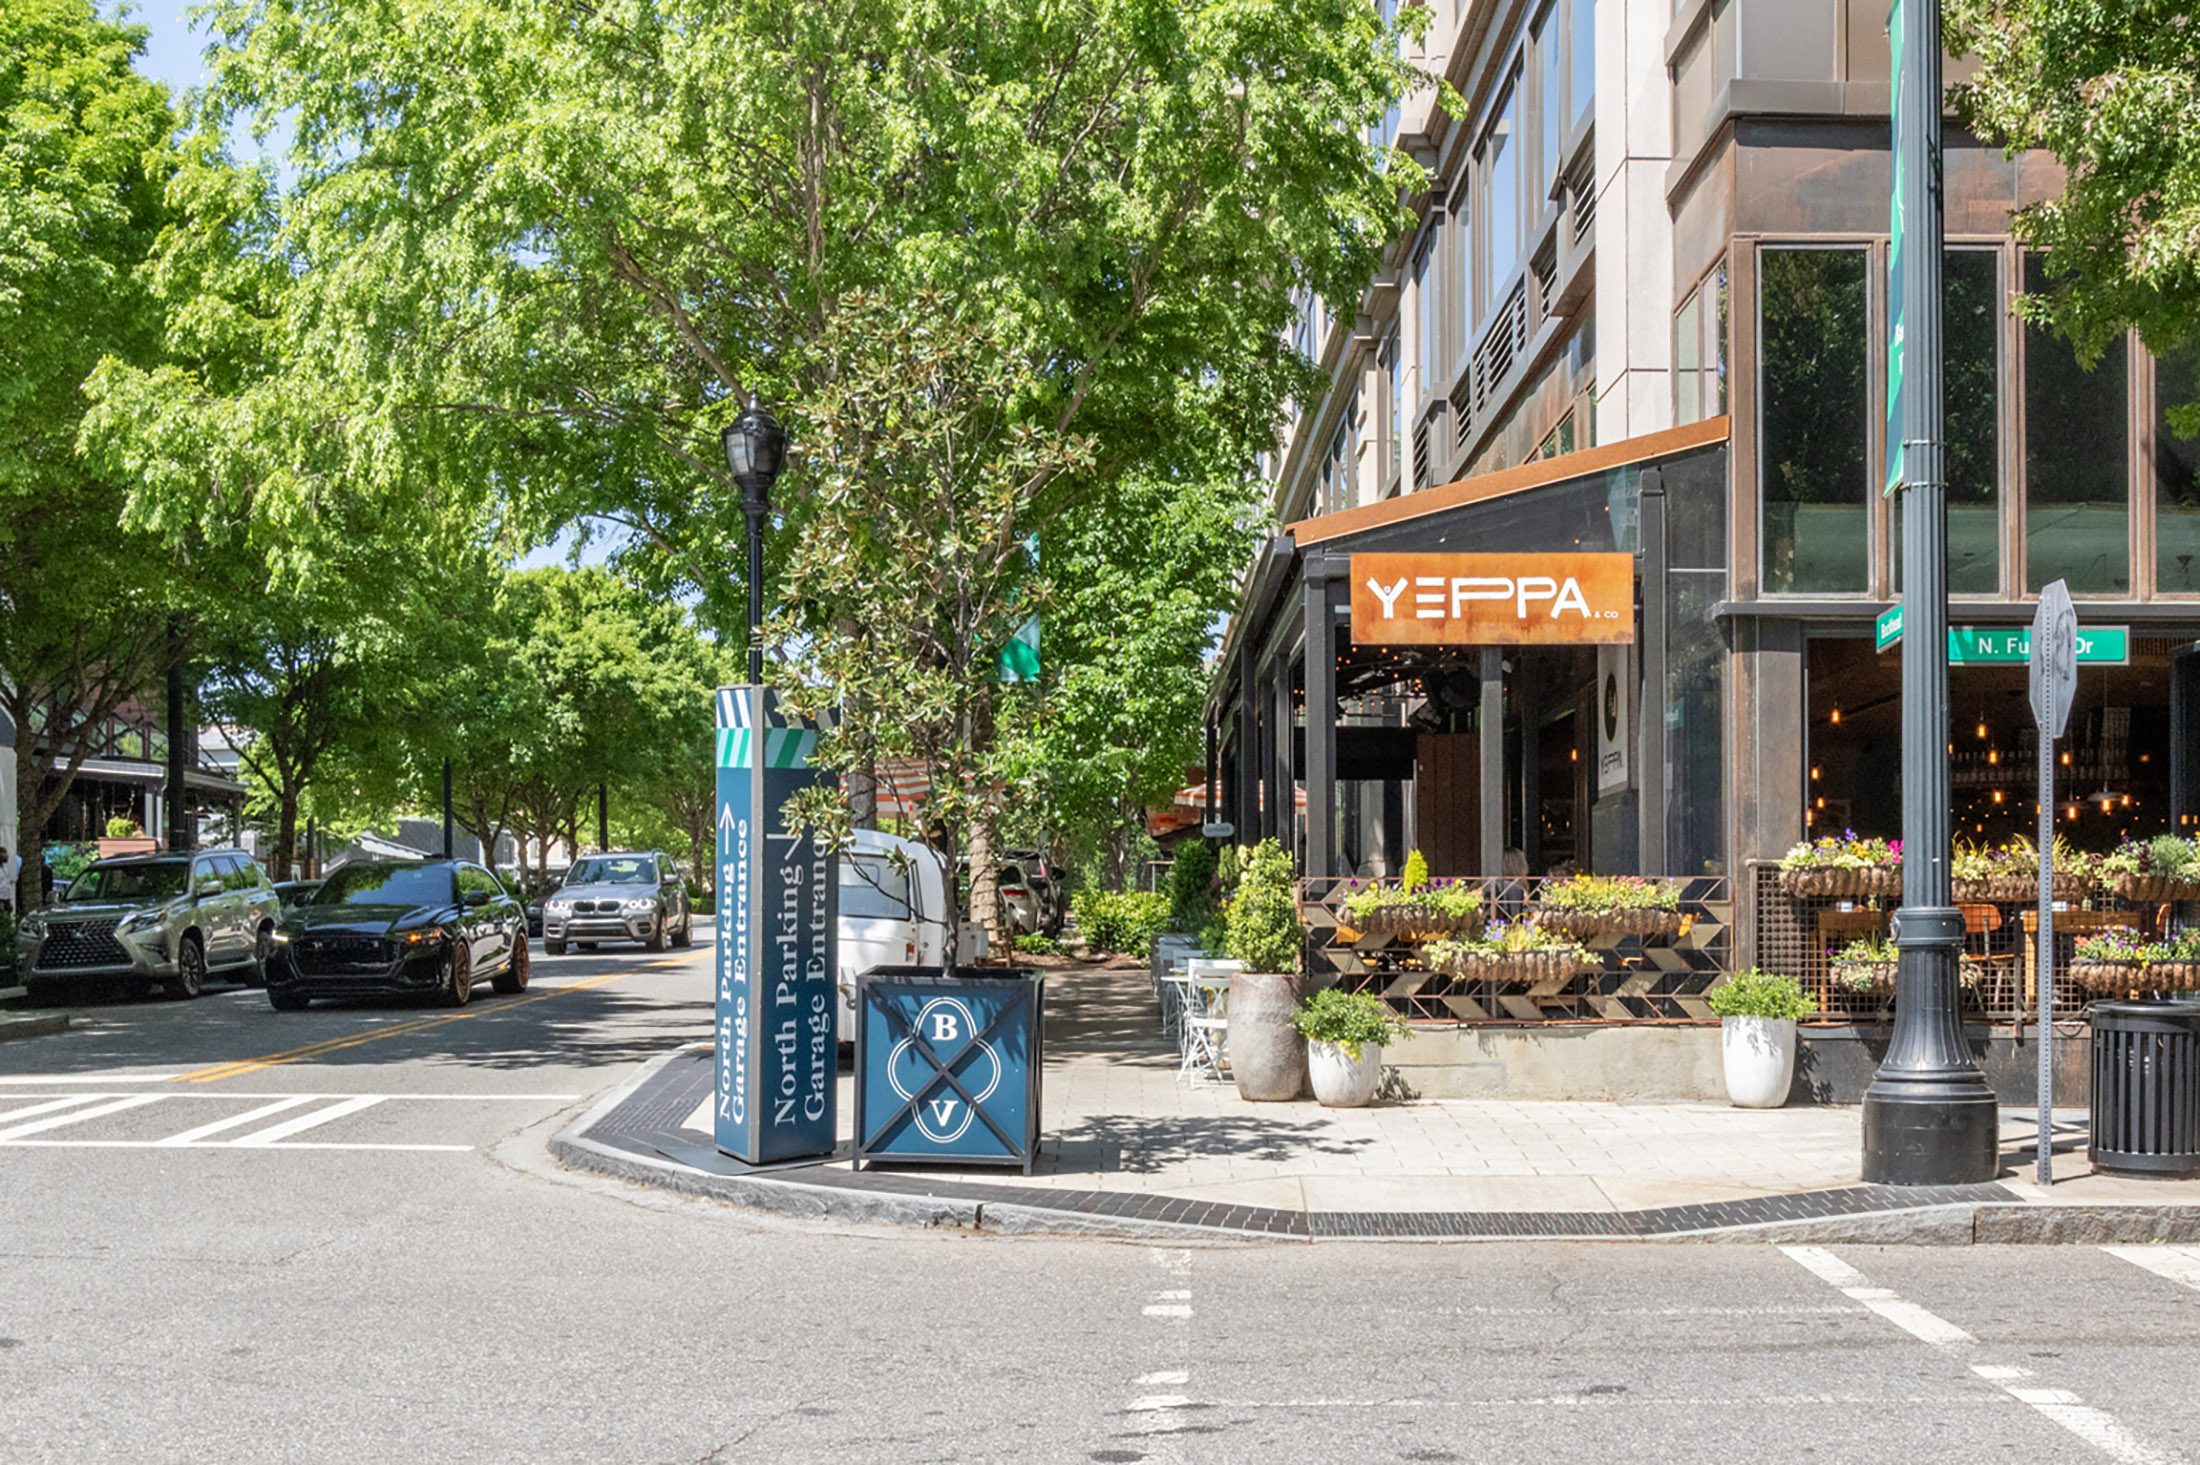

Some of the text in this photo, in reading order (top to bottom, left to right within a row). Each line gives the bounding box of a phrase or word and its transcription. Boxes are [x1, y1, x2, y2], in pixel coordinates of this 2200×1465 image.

[1366, 577, 1592, 619] YEPPA
[1603, 611, 1619, 619] CO
[1978, 637, 1998, 654] N.
[2075, 637, 2093, 654] Dr
[719, 862, 735, 1121] North Parking
[732, 819, 748, 1125] Garage Entrance
[774, 864, 804, 1127] North Parking
[804, 994, 830, 1121] Garage
[931, 1013, 958, 1041] B
[928, 1100, 959, 1127] V
